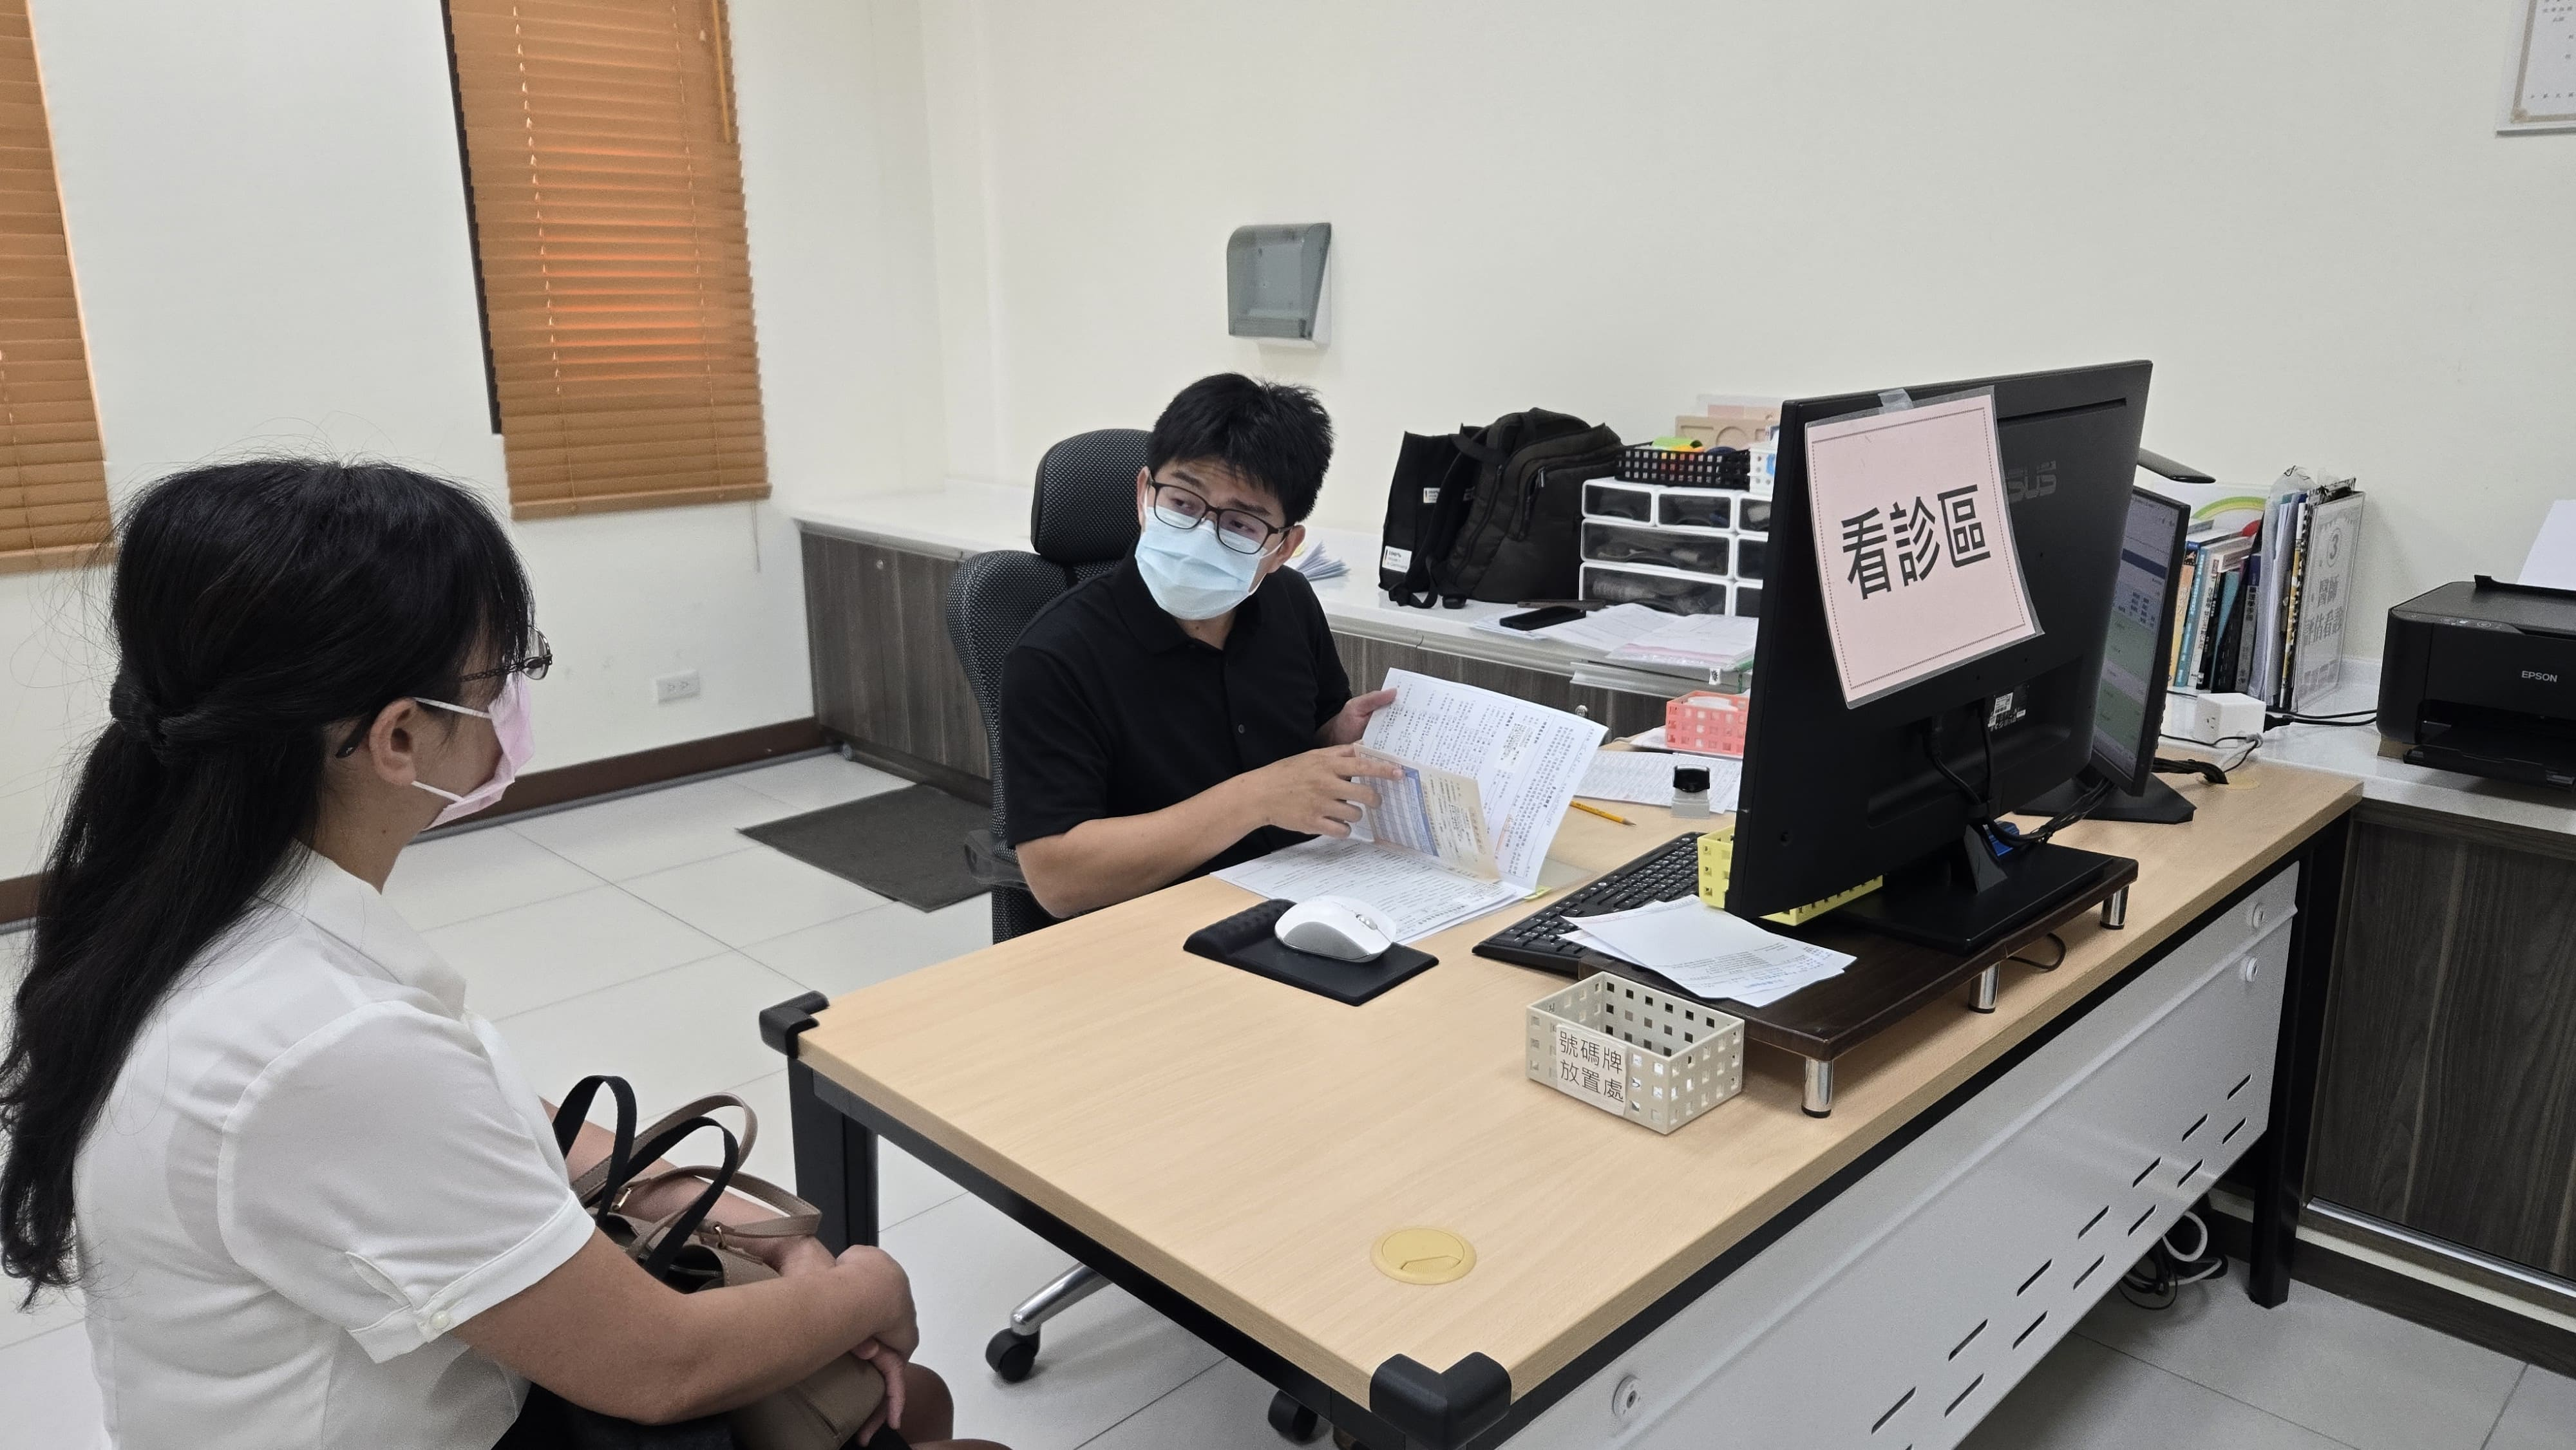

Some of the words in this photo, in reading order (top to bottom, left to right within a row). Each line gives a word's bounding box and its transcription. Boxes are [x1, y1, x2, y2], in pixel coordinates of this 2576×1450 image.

[2006, 460, 2056, 503] SUS
[1841, 484, 1991, 599] 看診區
[2521, 670, 2558, 683] EPSON
[1559, 1031, 1622, 1074] 號碼牌
[1560, 1059, 1624, 1102] 放置處
